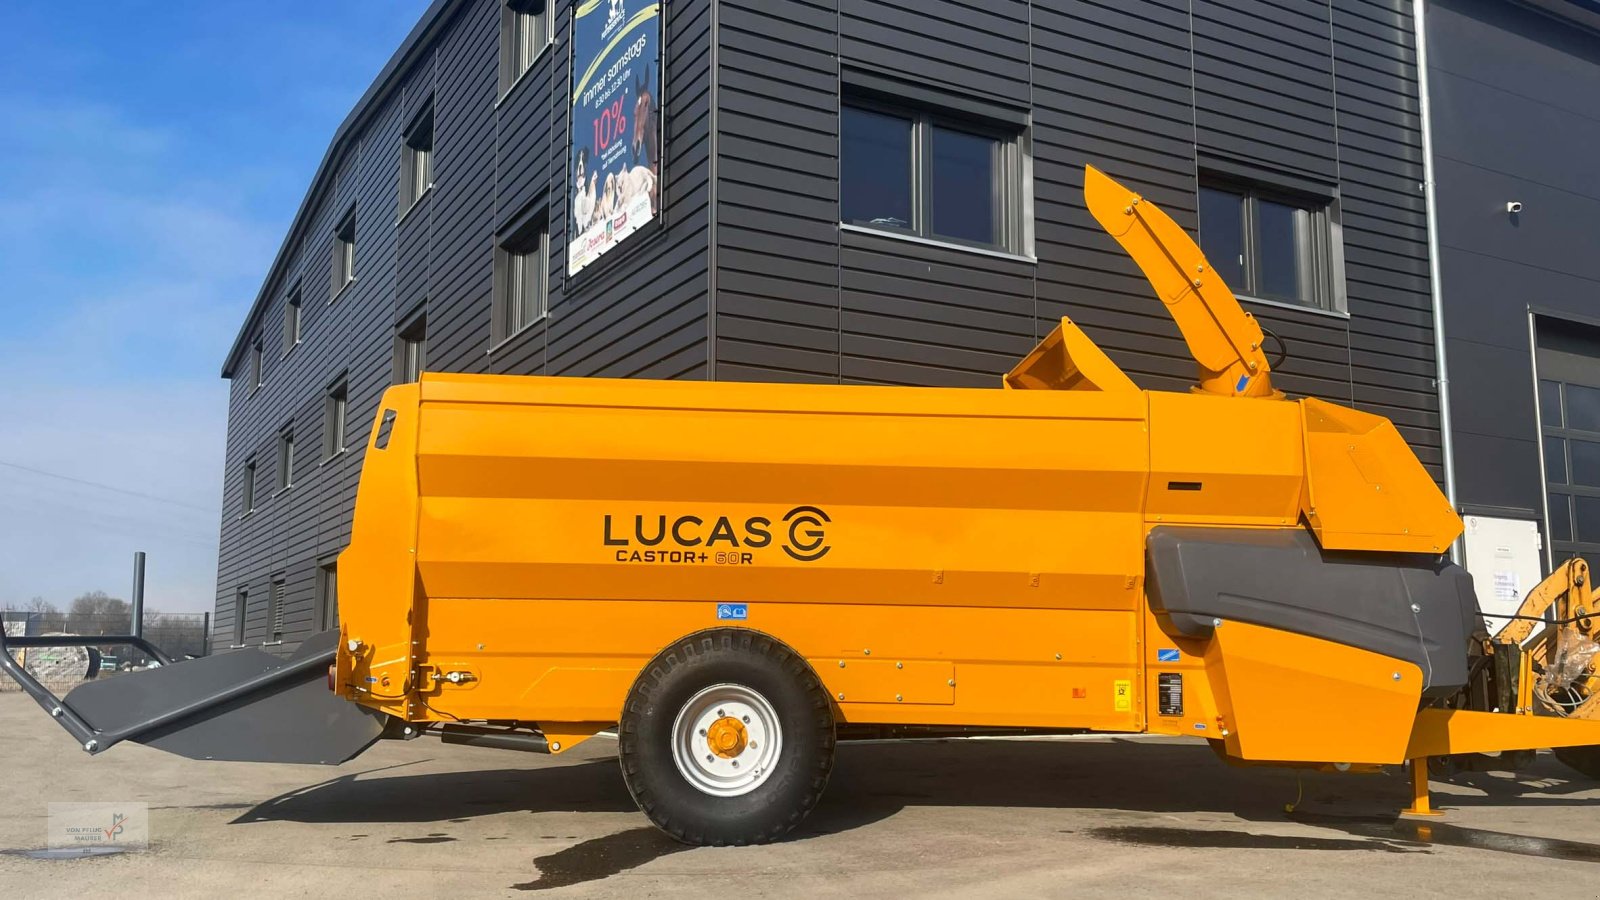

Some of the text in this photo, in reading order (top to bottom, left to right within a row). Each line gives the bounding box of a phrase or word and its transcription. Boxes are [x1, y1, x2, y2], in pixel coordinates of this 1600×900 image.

[583, 73, 606, 107] immer
[607, 33, 647, 81] samstags
[622, 68, 632, 81] Uhr
[603, 514, 772, 548] LUCAS
[616, 549, 754, 565] CASTOR+ 60R
